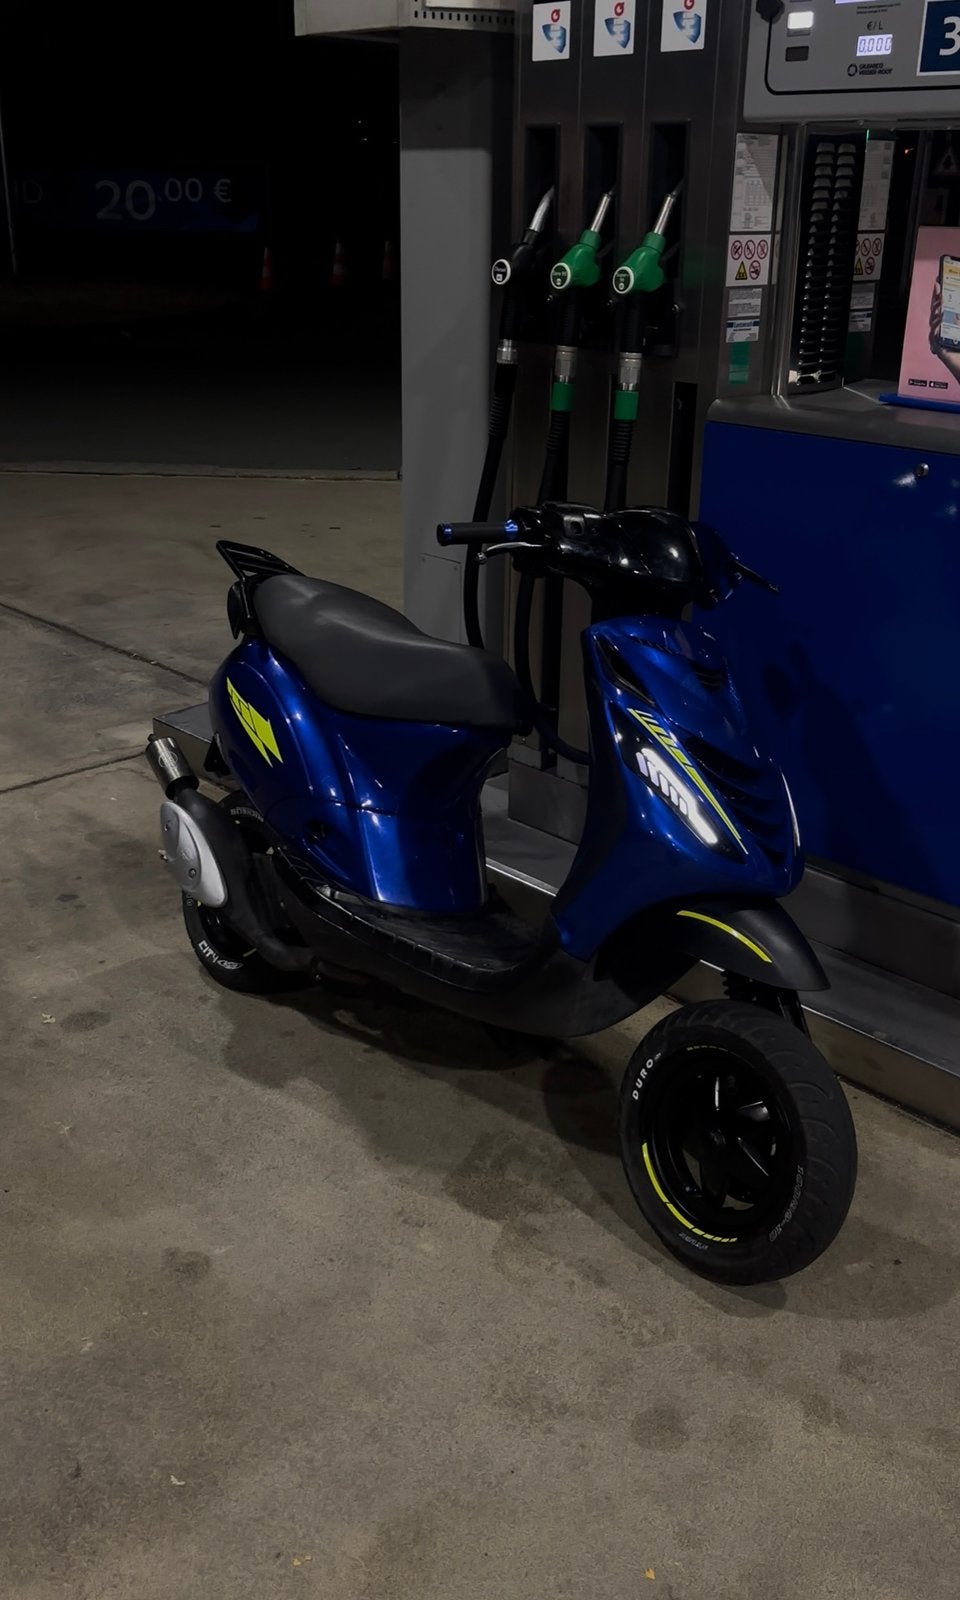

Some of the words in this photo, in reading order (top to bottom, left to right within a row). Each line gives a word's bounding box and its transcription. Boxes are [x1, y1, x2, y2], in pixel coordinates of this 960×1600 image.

[939, 15, 960, 56] 3
[198, 939, 219, 964] CITY
[632, 1058, 654, 1101] DURO
